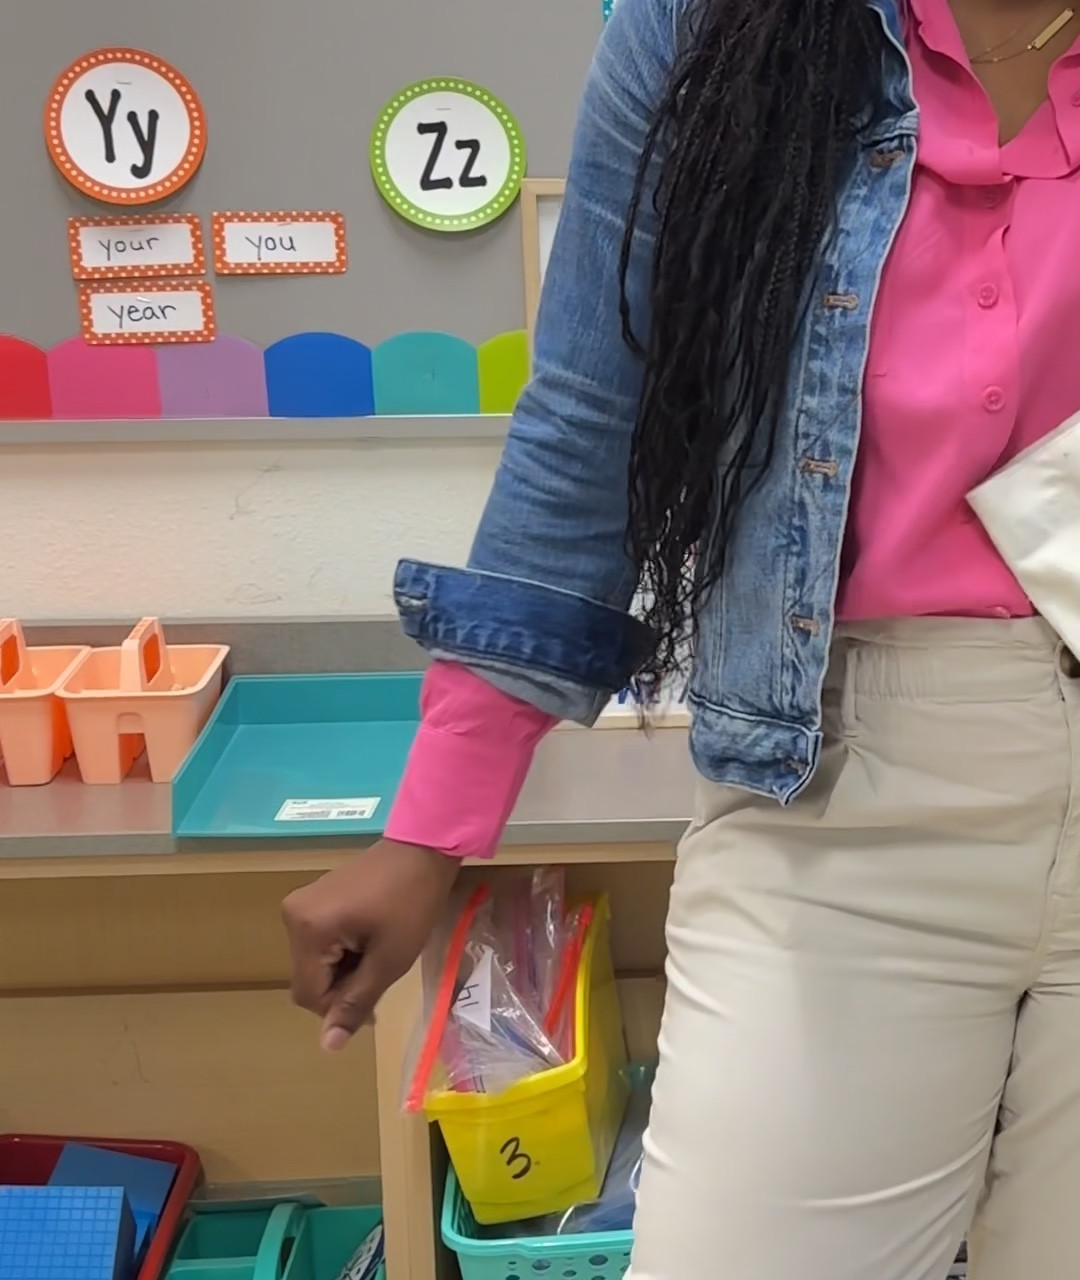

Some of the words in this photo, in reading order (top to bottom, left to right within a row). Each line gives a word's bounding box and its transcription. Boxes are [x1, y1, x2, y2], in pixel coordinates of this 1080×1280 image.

[85, 89, 159, 179] Yy
[416, 120, 488, 192] Zz
[99, 234, 159, 261] your
[246, 235, 296, 261] you
[107, 304, 176, 329] year
[500, 1136, 532, 1180] 3
